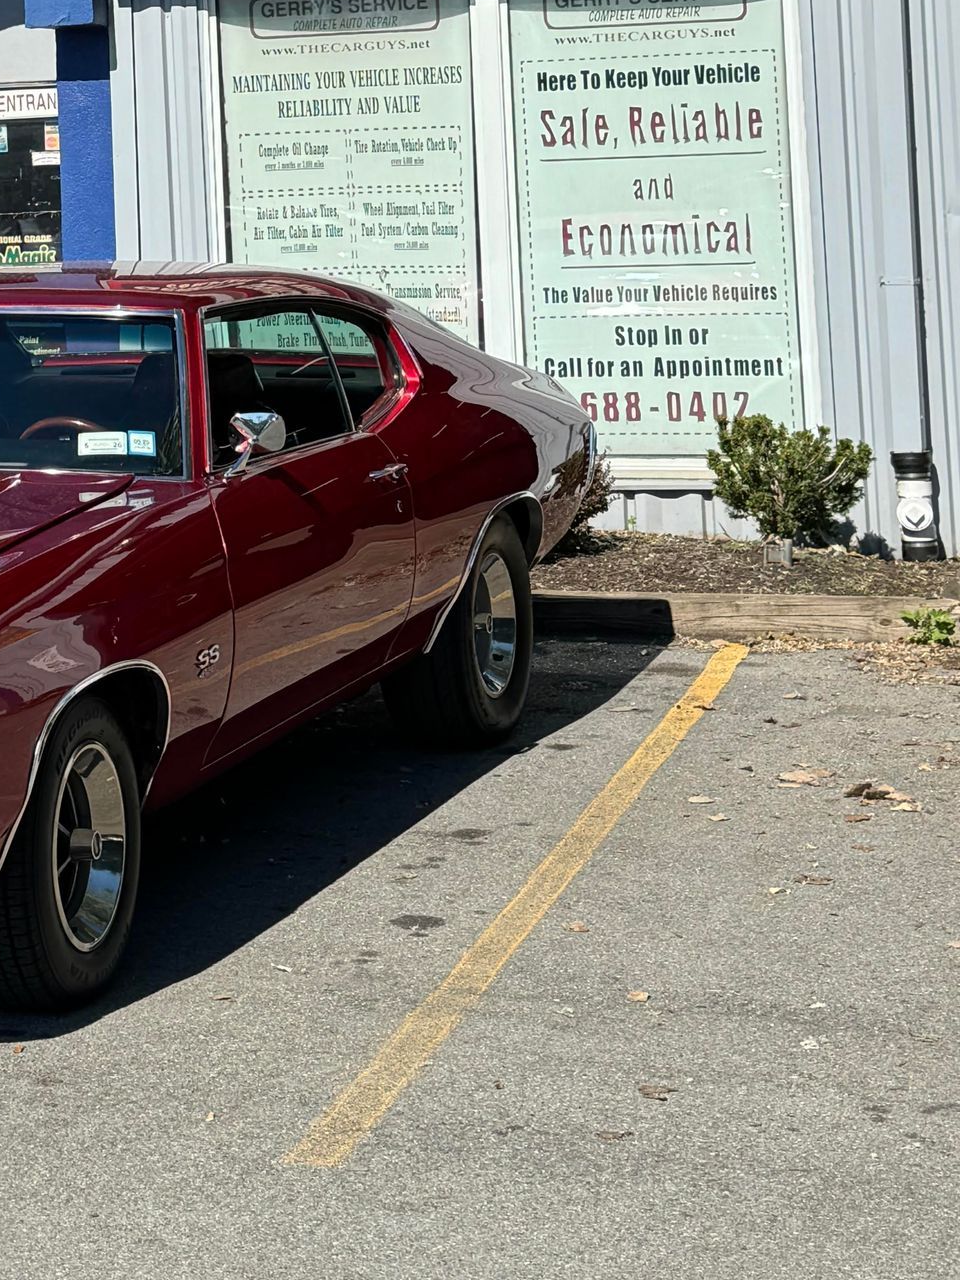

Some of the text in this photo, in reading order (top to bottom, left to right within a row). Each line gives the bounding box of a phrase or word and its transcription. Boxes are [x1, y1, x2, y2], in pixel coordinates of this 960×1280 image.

[588, 5, 701, 22] COMPLETE AUTO REPAIR
[293, 16, 398, 32] COMPLETE AUTO REPAIR
[554, 27, 736, 46] www.THECARGUYS.net
[261, 39, 431, 56] www.THECARGUYS.net
[232, 66, 462, 94] MAINTAINING YOUR VEHICLE INCREASES
[537, 62, 761, 92] Here To Keep Your Vehicle
[277, 95, 421, 119] RELIABILITY AND VALUE
[540, 101, 763, 149] Safe, Reliable
[258, 143, 329, 160] Complete Oil Change
[354, 140, 369, 154] Tire
[426, 138, 446, 151] Check
[447, 137, 458, 154] Up
[632, 173, 674, 200] and
[257, 206, 279, 220] Rotate
[282, 206, 288, 218] &
[320, 204, 340, 219] Tires,
[362, 202, 384, 216] Wheel
[386, 202, 421, 219] Alignment,
[437, 201, 455, 215] Filter
[253, 224, 343, 241] Air Filter, Cabin Air Filter
[361, 223, 377, 237] Fuel
[430, 222, 458, 237] Cleaning
[561, 213, 753, 257] Economical
[386, 283, 433, 299] Transmission
[435, 283, 462, 301] Service,
[543, 283, 778, 305] The Value Your Vehicle Requires
[283, 312, 314, 326] Steerin
[276, 333, 300, 348] Brake
[615, 325, 709, 348] Stop In or
[544, 356, 784, 379] Call for an Appointment
[580, 391, 749, 423] 688-0402
